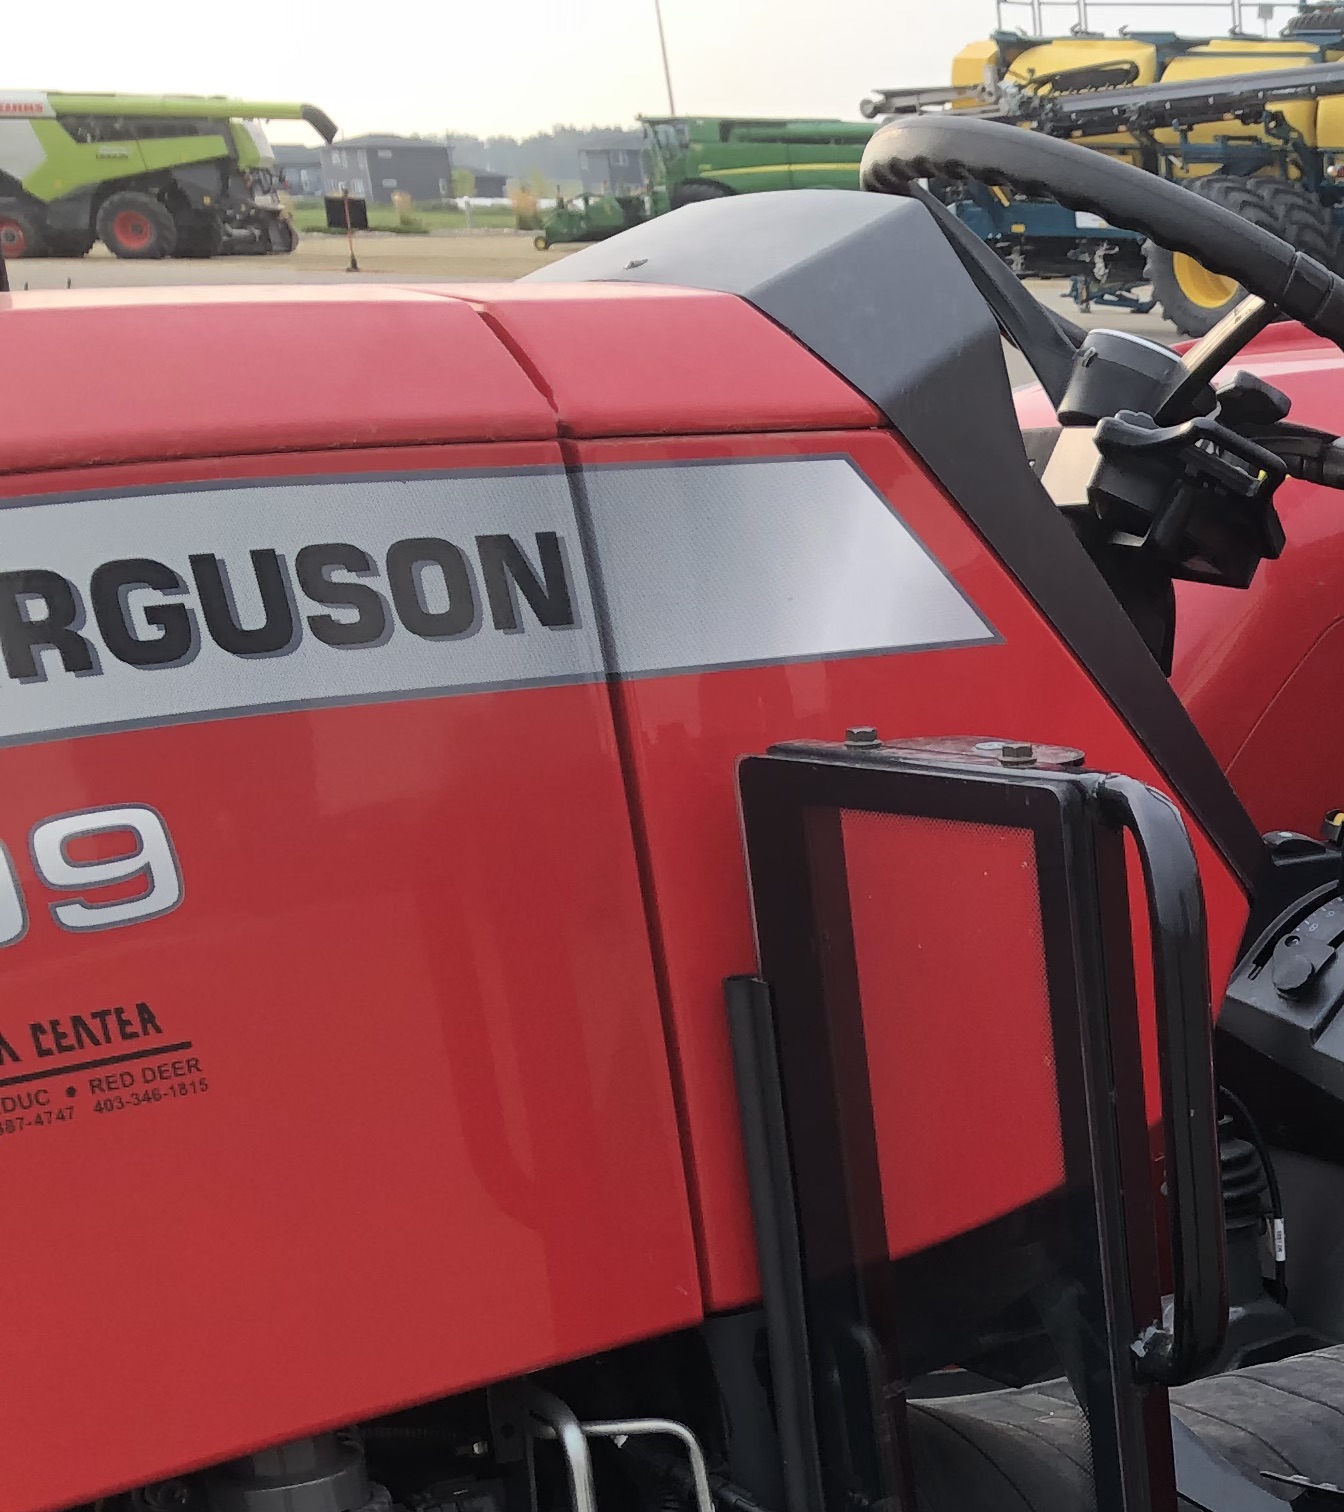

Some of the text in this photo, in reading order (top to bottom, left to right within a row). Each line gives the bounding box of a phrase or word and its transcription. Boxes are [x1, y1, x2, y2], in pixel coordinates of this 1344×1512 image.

[0, 531, 582, 685] RGUSON
[0, 802, 185, 949] 9
[89, 1057, 202, 1095] RED DEER
